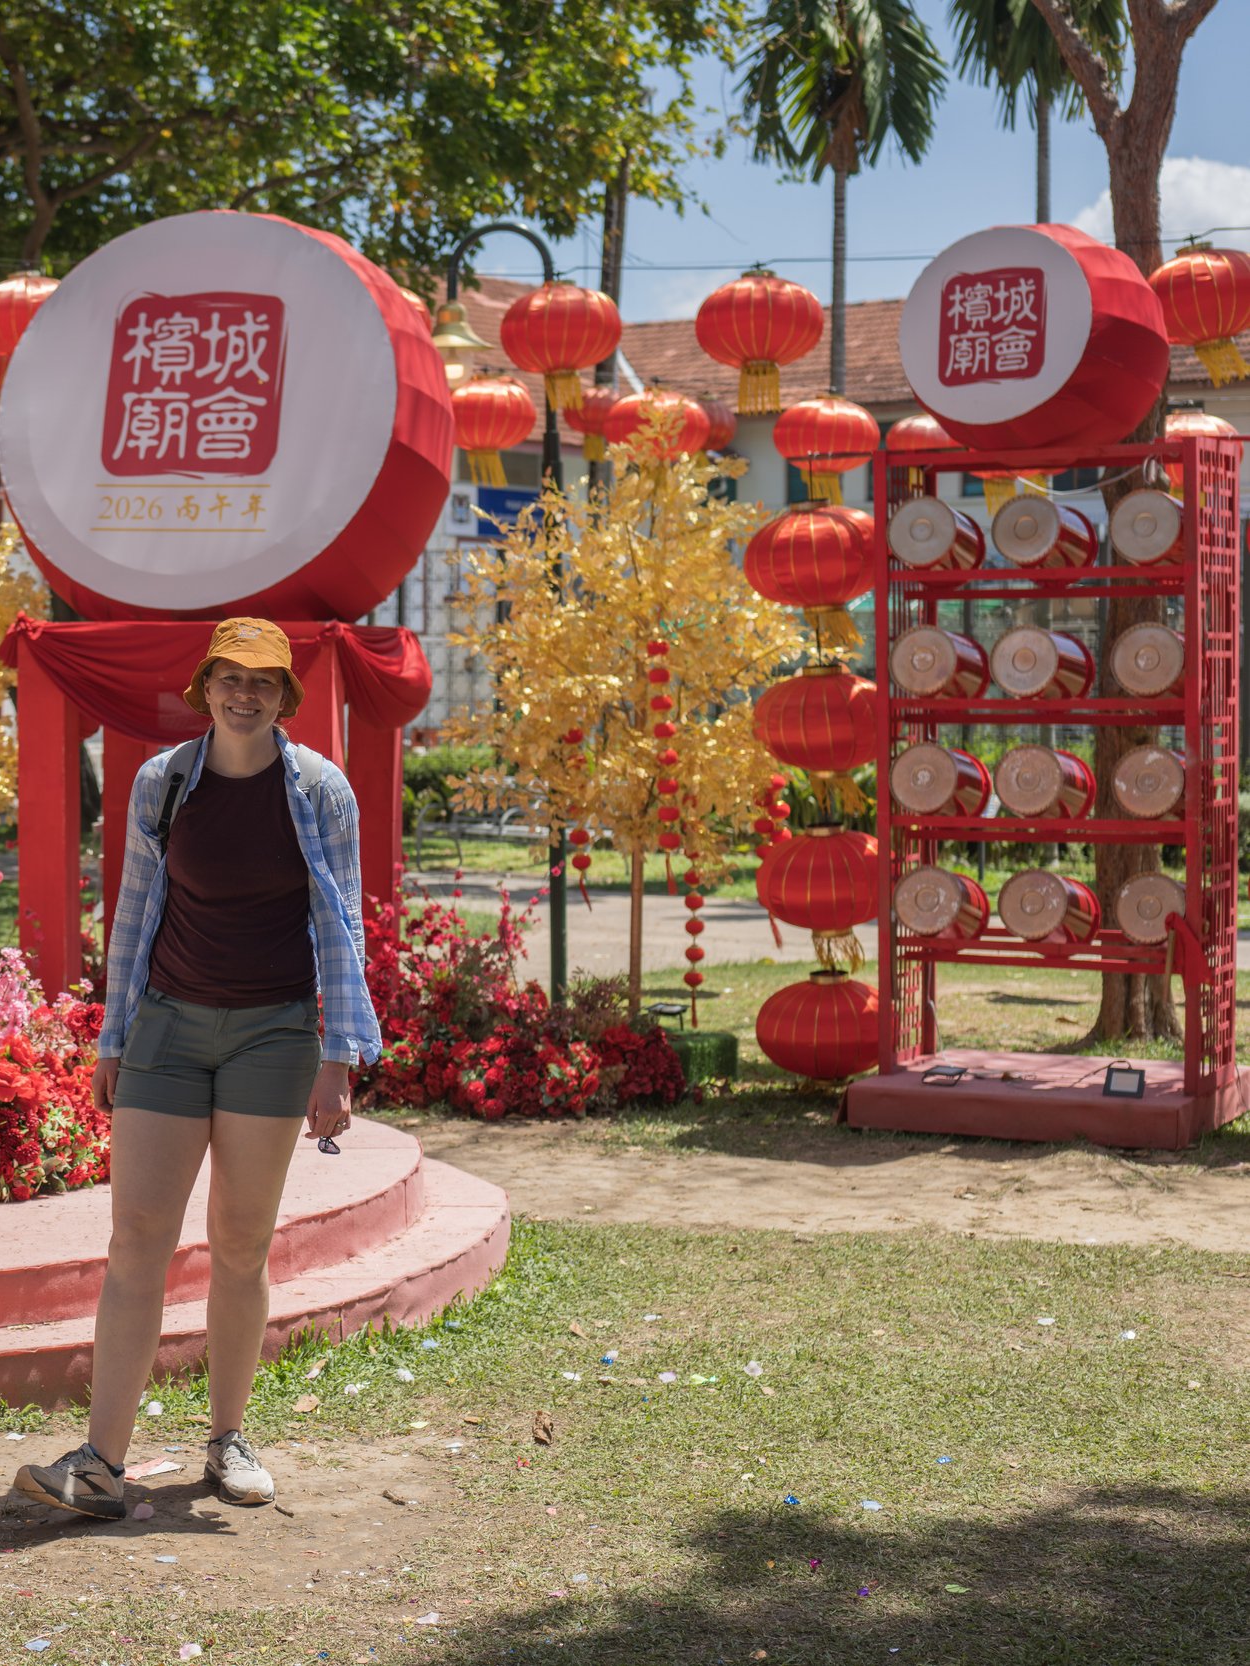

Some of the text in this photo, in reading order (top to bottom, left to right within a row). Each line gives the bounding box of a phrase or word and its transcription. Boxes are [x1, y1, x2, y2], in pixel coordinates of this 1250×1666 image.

[948, 278, 1037, 330] 檳城
[123, 312, 270, 384] 檳城
[945, 325, 1036, 378] 廟會
[112, 386, 267, 460] 廟會
[98, 493, 266, 522] 2026 丙午年
